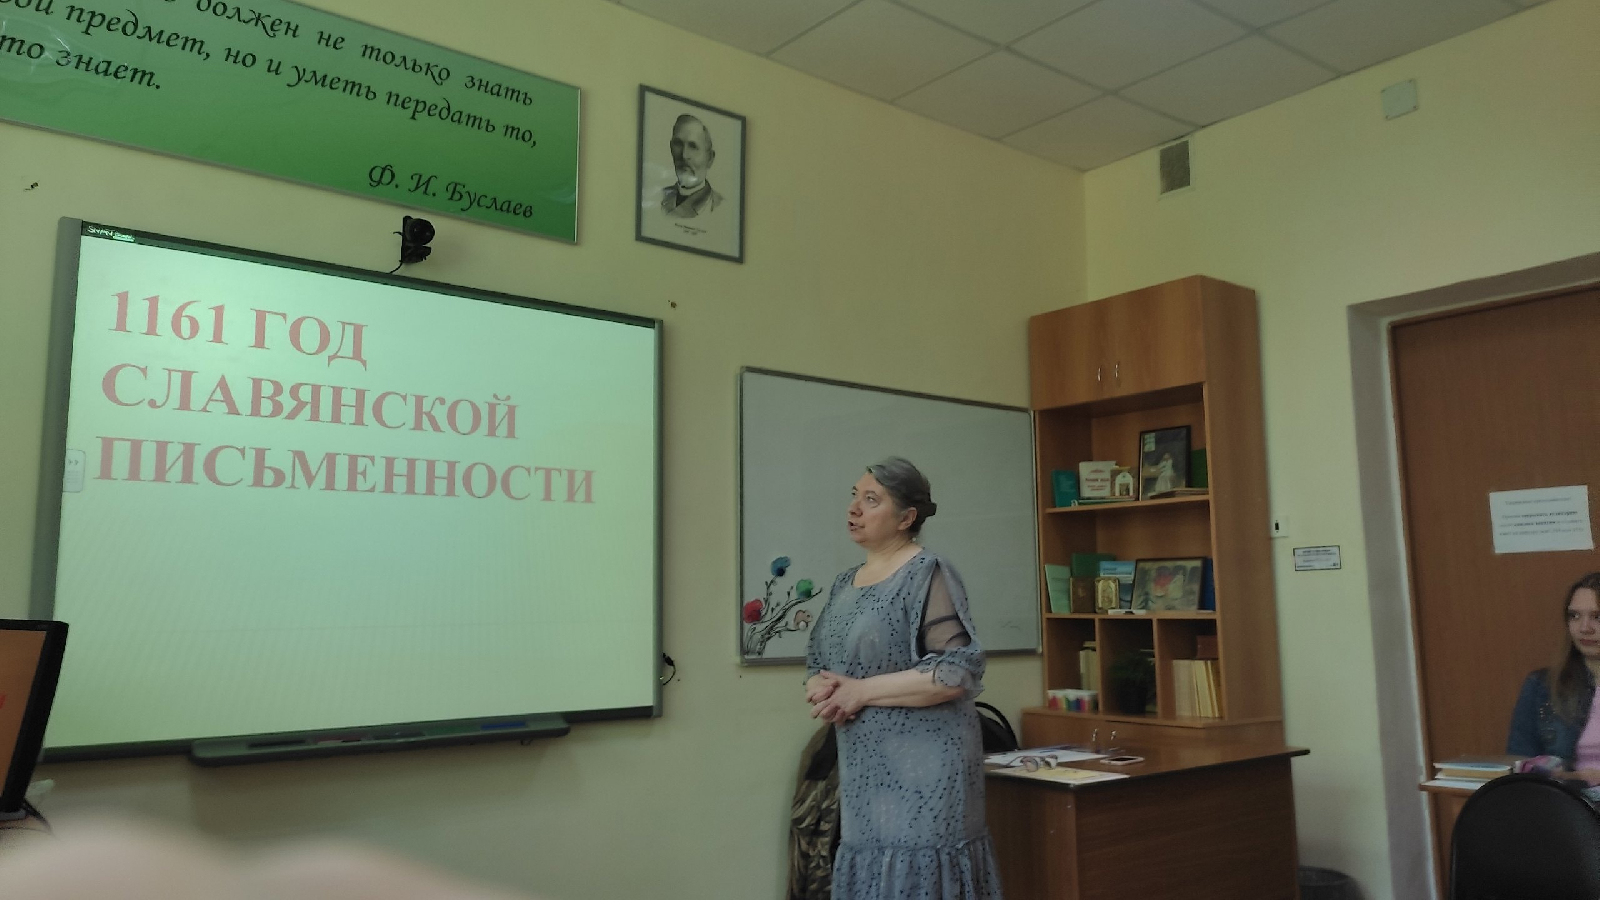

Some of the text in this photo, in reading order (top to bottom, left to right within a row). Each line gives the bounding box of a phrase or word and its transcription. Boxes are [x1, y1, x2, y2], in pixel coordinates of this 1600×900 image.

[56, 49, 160, 90] знает.
[66, 3, 210, 61] предмет,
[224, 47, 256, 68] но
[266, 58, 281, 75] и
[287, 65, 377, 100] уметь
[386, 90, 496, 132] передать
[503, 123, 537, 148] то,
[317, 30, 345, 50] не
[361, 43, 450, 86] только
[465, 75, 533, 106] знать
[368, 164, 533, 218] Ф. И. Буслаев
[108, 290, 369, 371] 1161 ГОД
[101, 362, 520, 440] СЛАВЯНСКОЙ
[93, 435, 597, 504] ПИСЬМЕННОСТИ
